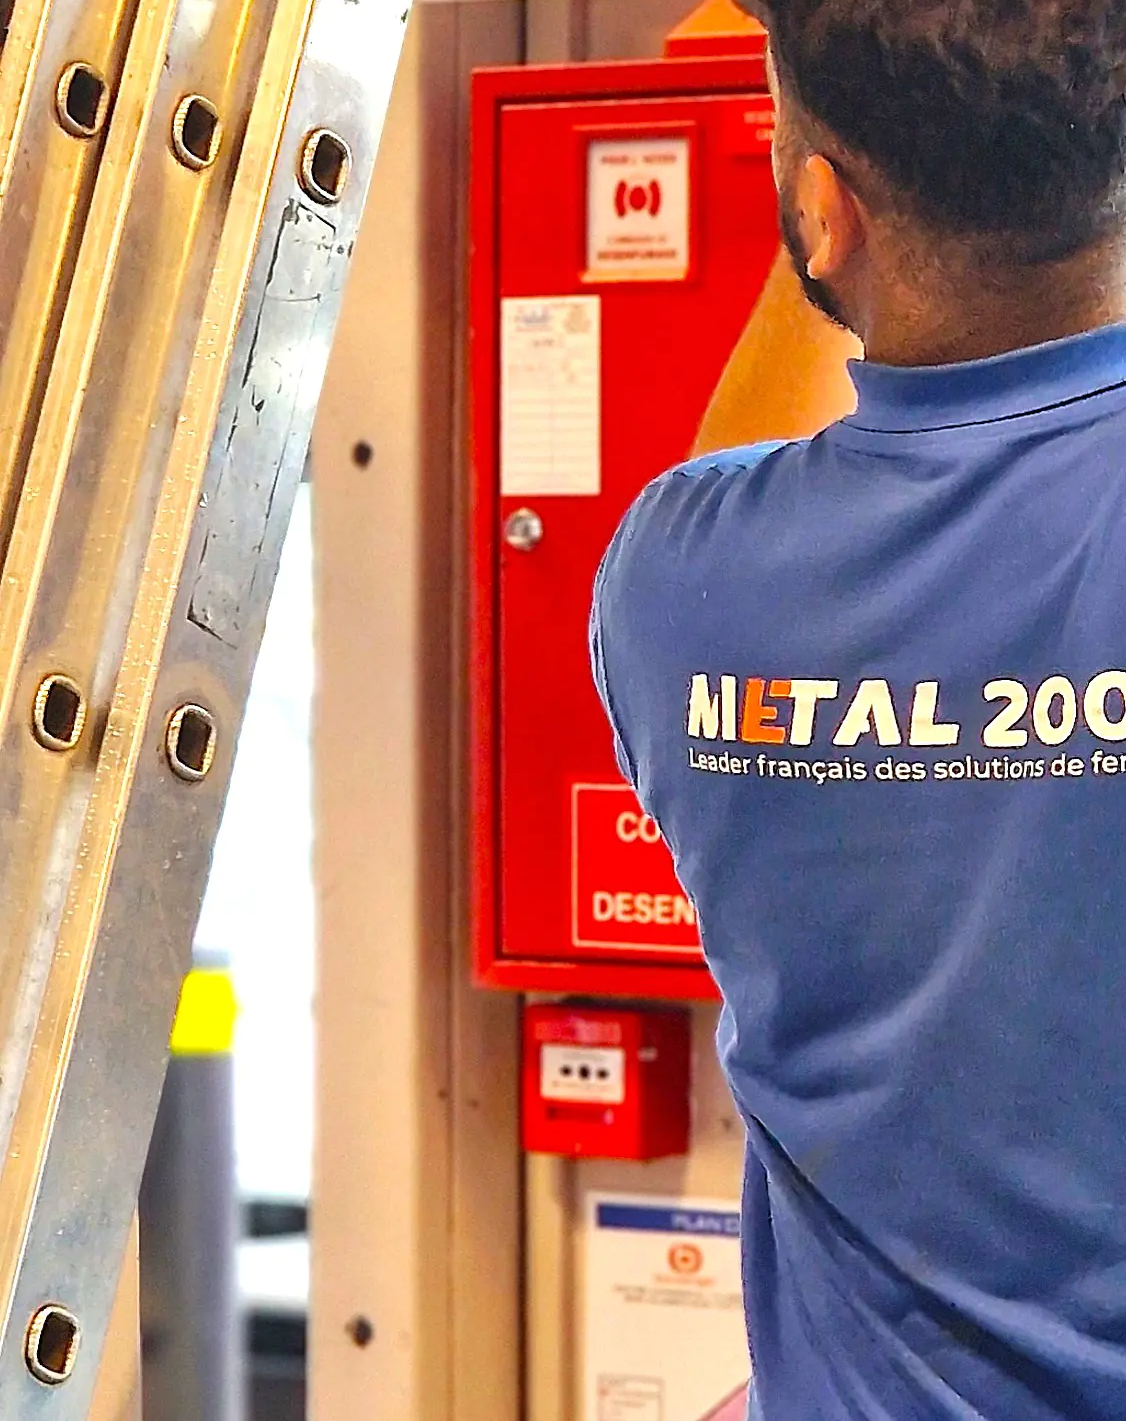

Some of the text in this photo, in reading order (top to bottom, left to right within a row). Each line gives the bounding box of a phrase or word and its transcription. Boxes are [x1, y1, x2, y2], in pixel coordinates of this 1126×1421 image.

[686, 673, 961, 747] METAL
[687, 747, 751, 775] Leader
[756, 753, 868, 785] français
[874, 756, 927, 780] des
[932, 754, 1045, 780] solutions
[1050, 752, 1085, 777] de
